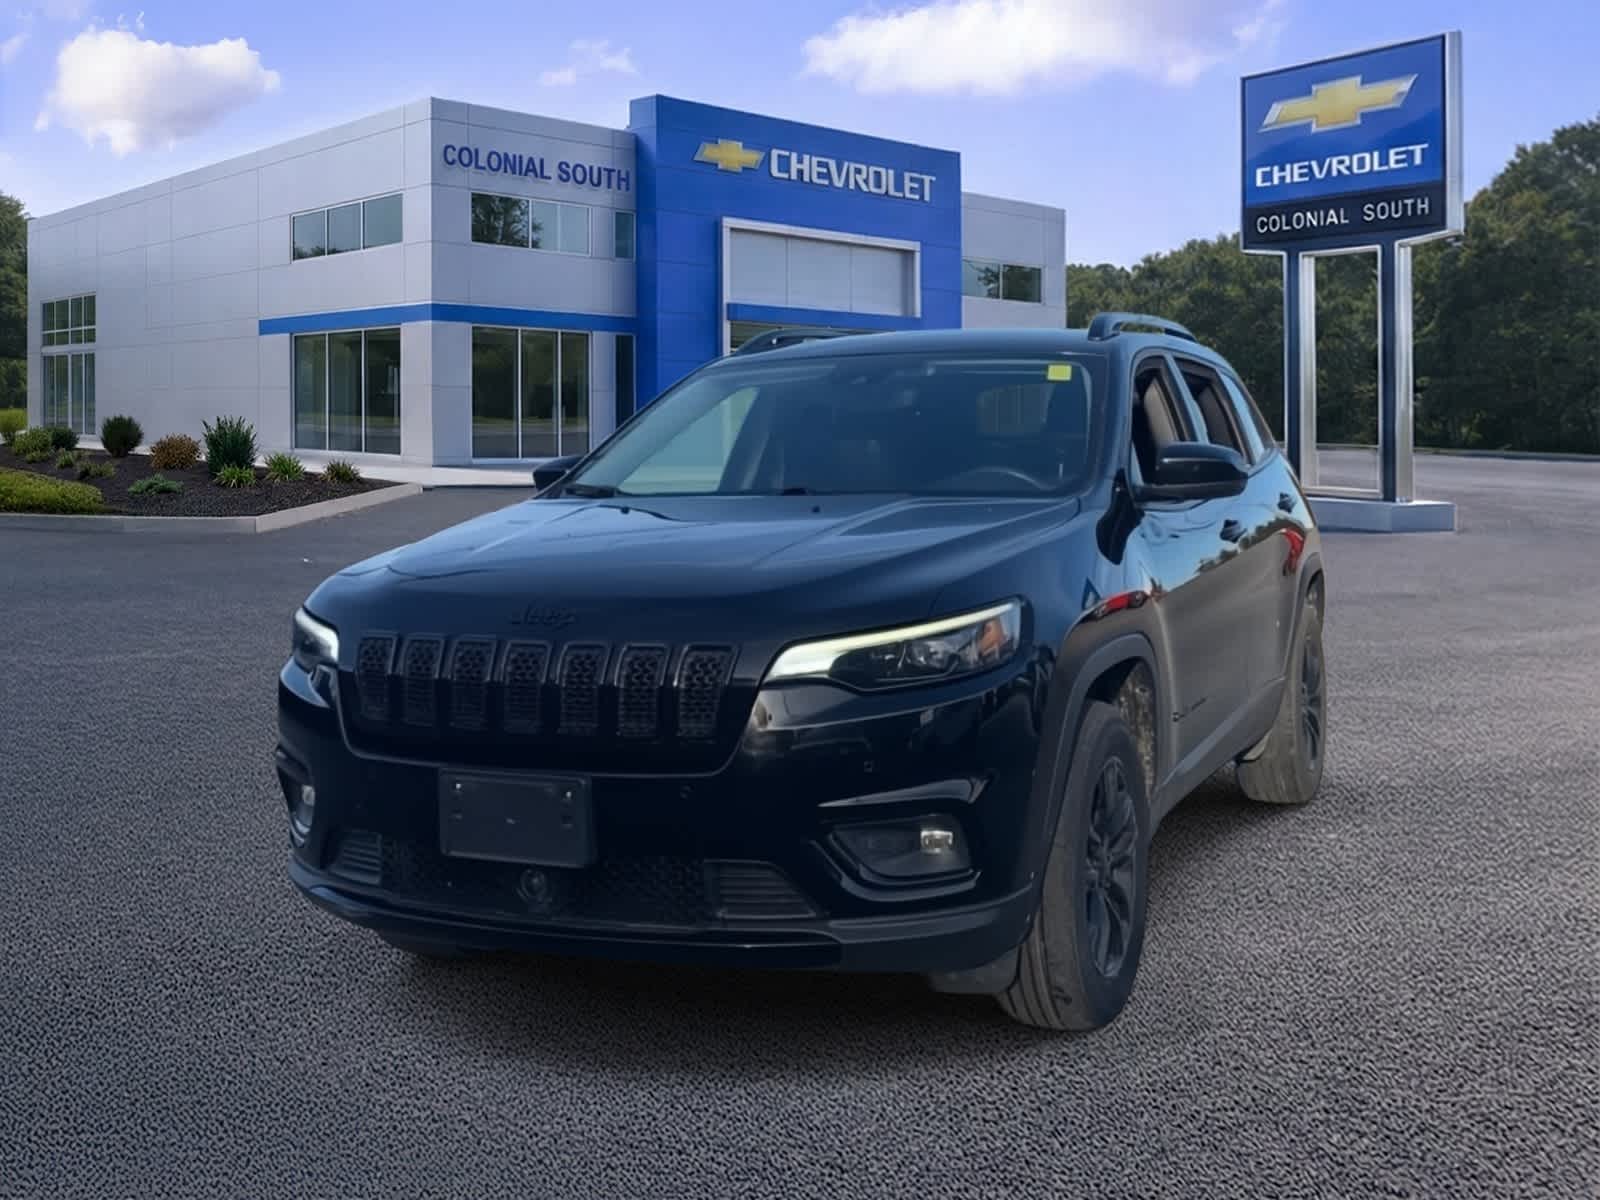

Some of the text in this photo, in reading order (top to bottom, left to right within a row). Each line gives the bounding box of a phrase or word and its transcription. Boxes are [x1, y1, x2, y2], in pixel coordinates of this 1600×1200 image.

[443, 145, 630, 191] COLONIAL SOUTH
[770, 148, 936, 203] CHEVROLET
[1255, 143, 1429, 187] CHEVROLET
[1256, 197, 1430, 234] COLONIAL SOUTH
